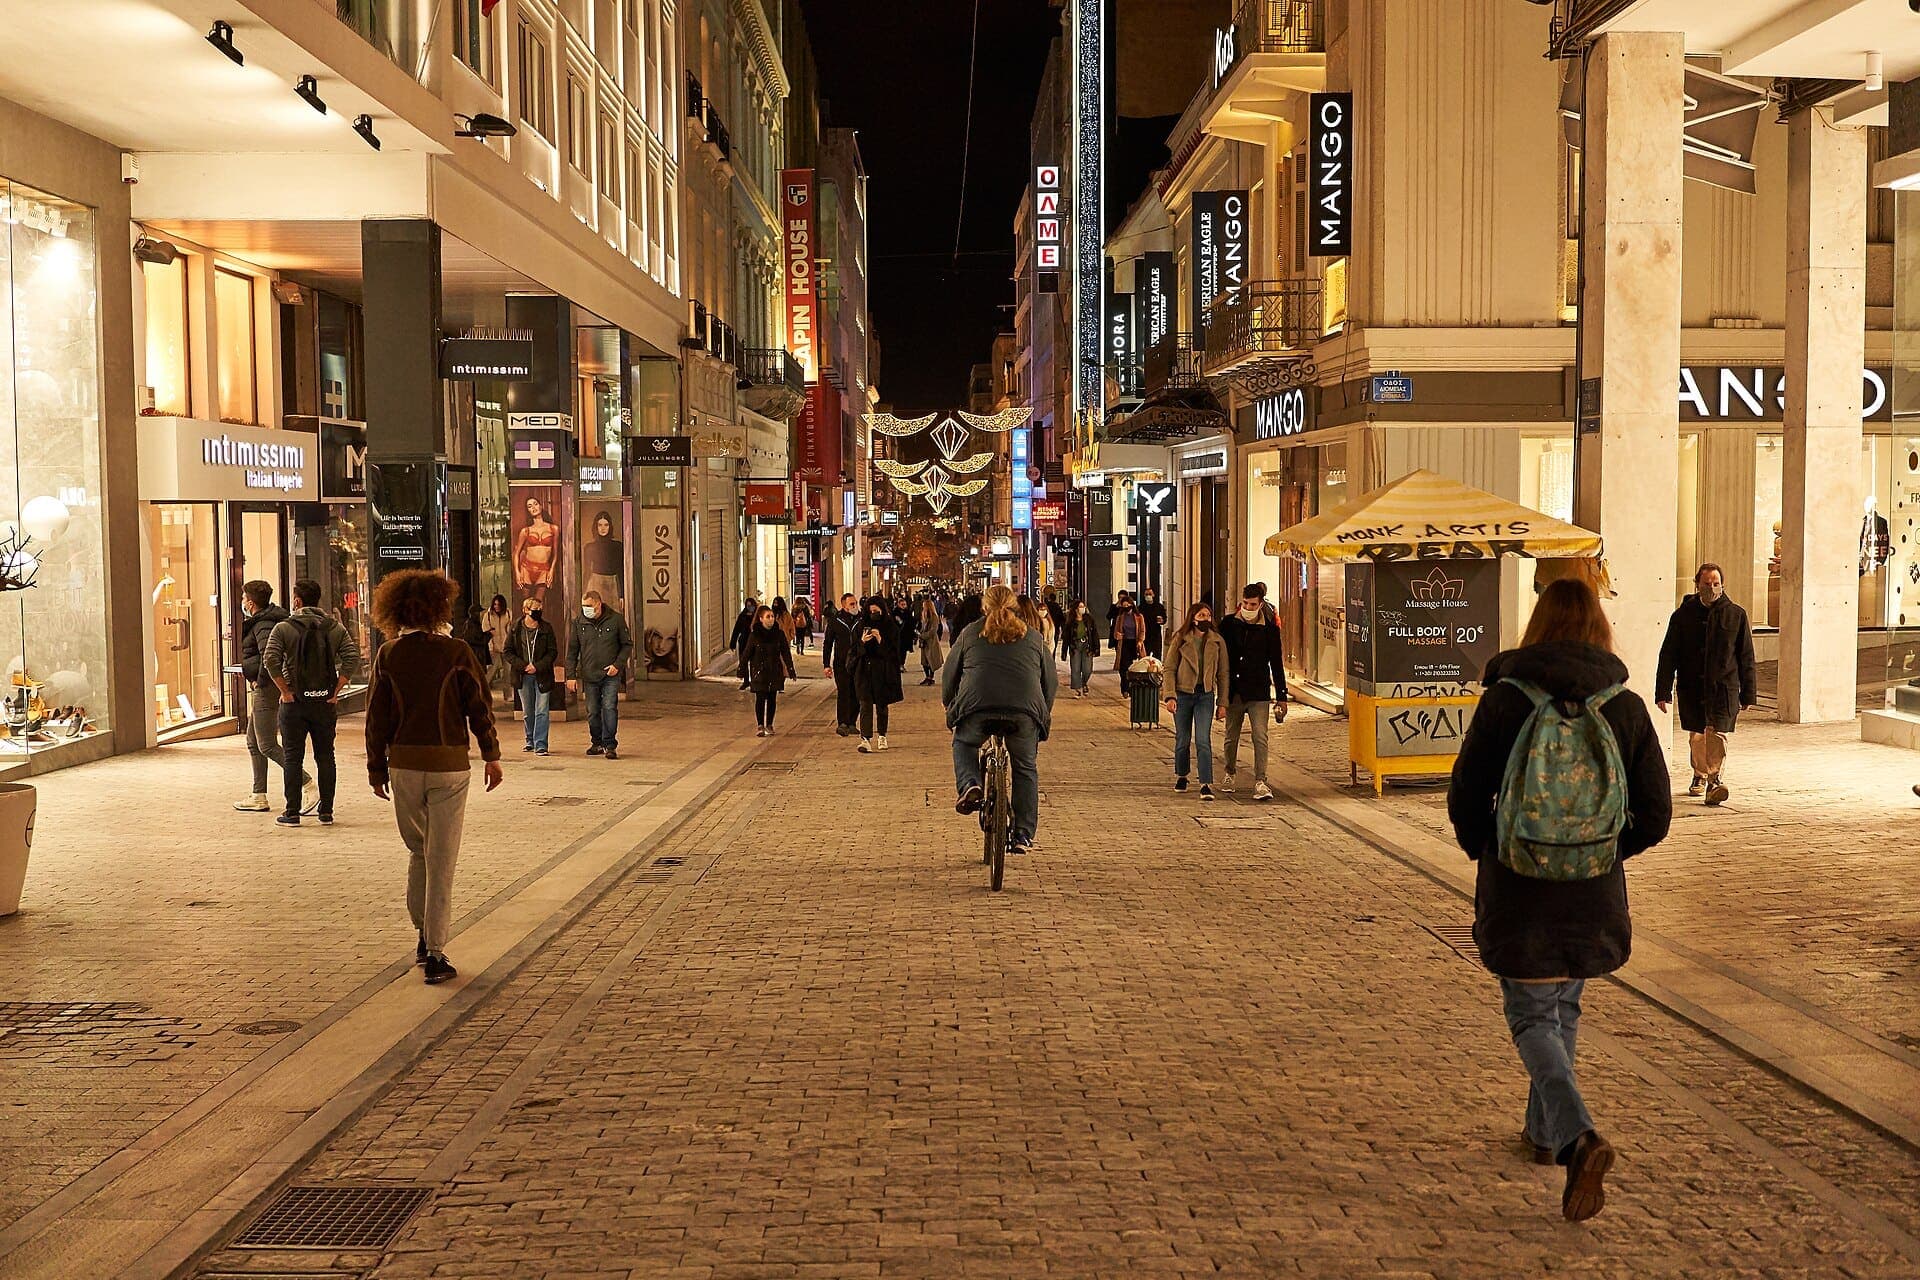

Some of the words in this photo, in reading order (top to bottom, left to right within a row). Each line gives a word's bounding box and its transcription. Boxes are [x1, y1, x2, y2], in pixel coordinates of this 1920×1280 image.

[1320, 100, 1343, 245] MANGO
[1201, 212, 1211, 257] EAGLE
[790, 219, 809, 295] HOUSE
[1150, 267, 1160, 305] EAGLE
[793, 305, 812, 368] APIN
[452, 364, 528, 375] intimissimi
[510, 416, 559, 426] MED
[1255, 388, 1305, 440] MANGO
[203, 434, 303, 469] intimissimi
[245, 469, 272, 488] Italian
[1068, 491, 1083, 500] Ths
[1093, 491, 1111, 502] Ths
[647, 524, 673, 604] kellys
[1405, 599, 1440, 609] Massage
[1388, 626, 1414, 637] FULL
[1416, 626, 1447, 637] BODY
[1456, 625, 1485, 643] 20€
[1407, 638, 1447, 646] MASSAGE
[304, 689, 329, 697] adidas
